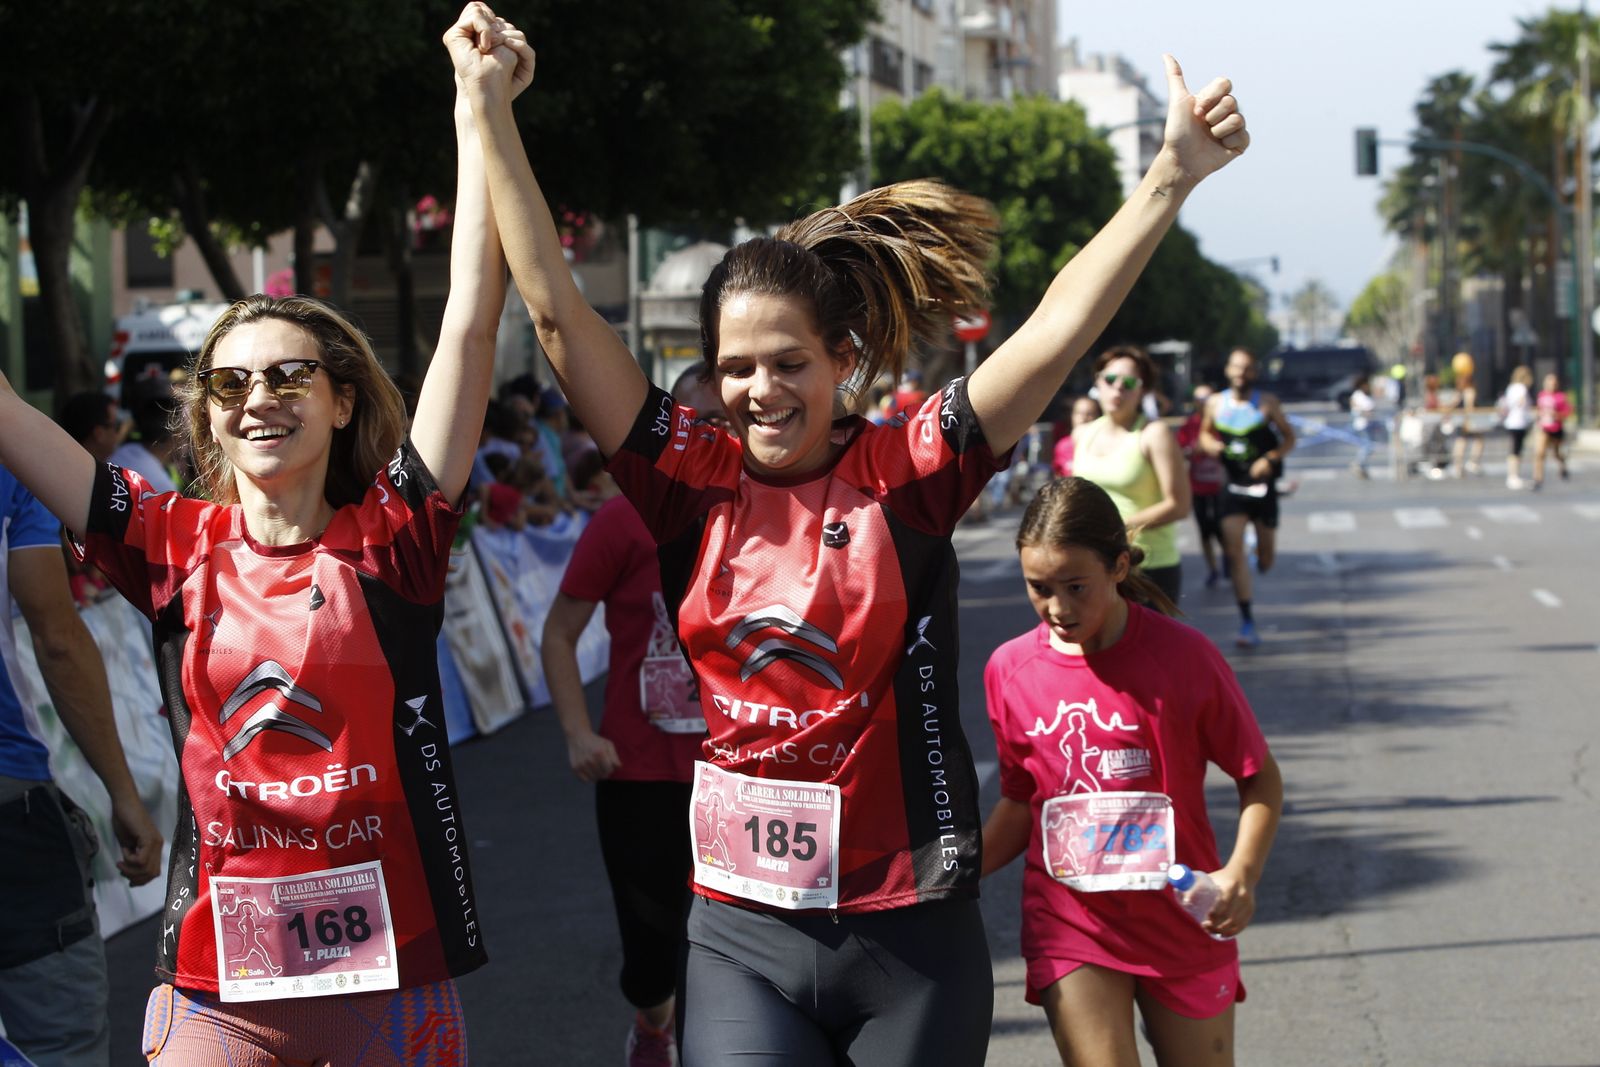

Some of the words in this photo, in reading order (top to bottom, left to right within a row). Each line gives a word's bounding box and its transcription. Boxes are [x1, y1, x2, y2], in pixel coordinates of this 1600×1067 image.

[651, 396, 673, 436] CAR
[919, 665, 935, 692] DS
[742, 784, 782, 800] CARRERA
[783, 789, 832, 804] SOLIDARIA
[922, 703, 958, 871] AUTOMOBILES
[204, 821, 318, 850] SALINAS
[326, 815, 384, 849] CAR
[421, 744, 441, 772] DS
[431, 782, 477, 947] AUTOMOBILES
[745, 816, 817, 862] 185
[1082, 823, 1167, 853] 1782
[757, 856, 790, 872] MARTA
[278, 881, 324, 896] CARRERA
[325, 872, 375, 890] SOLIDARIA
[172, 886, 190, 911] DS
[287, 905, 372, 949] 168
[304, 951, 313, 962] T.
[317, 946, 351, 960] PLAZA
[247, 968, 265, 976] Salle
